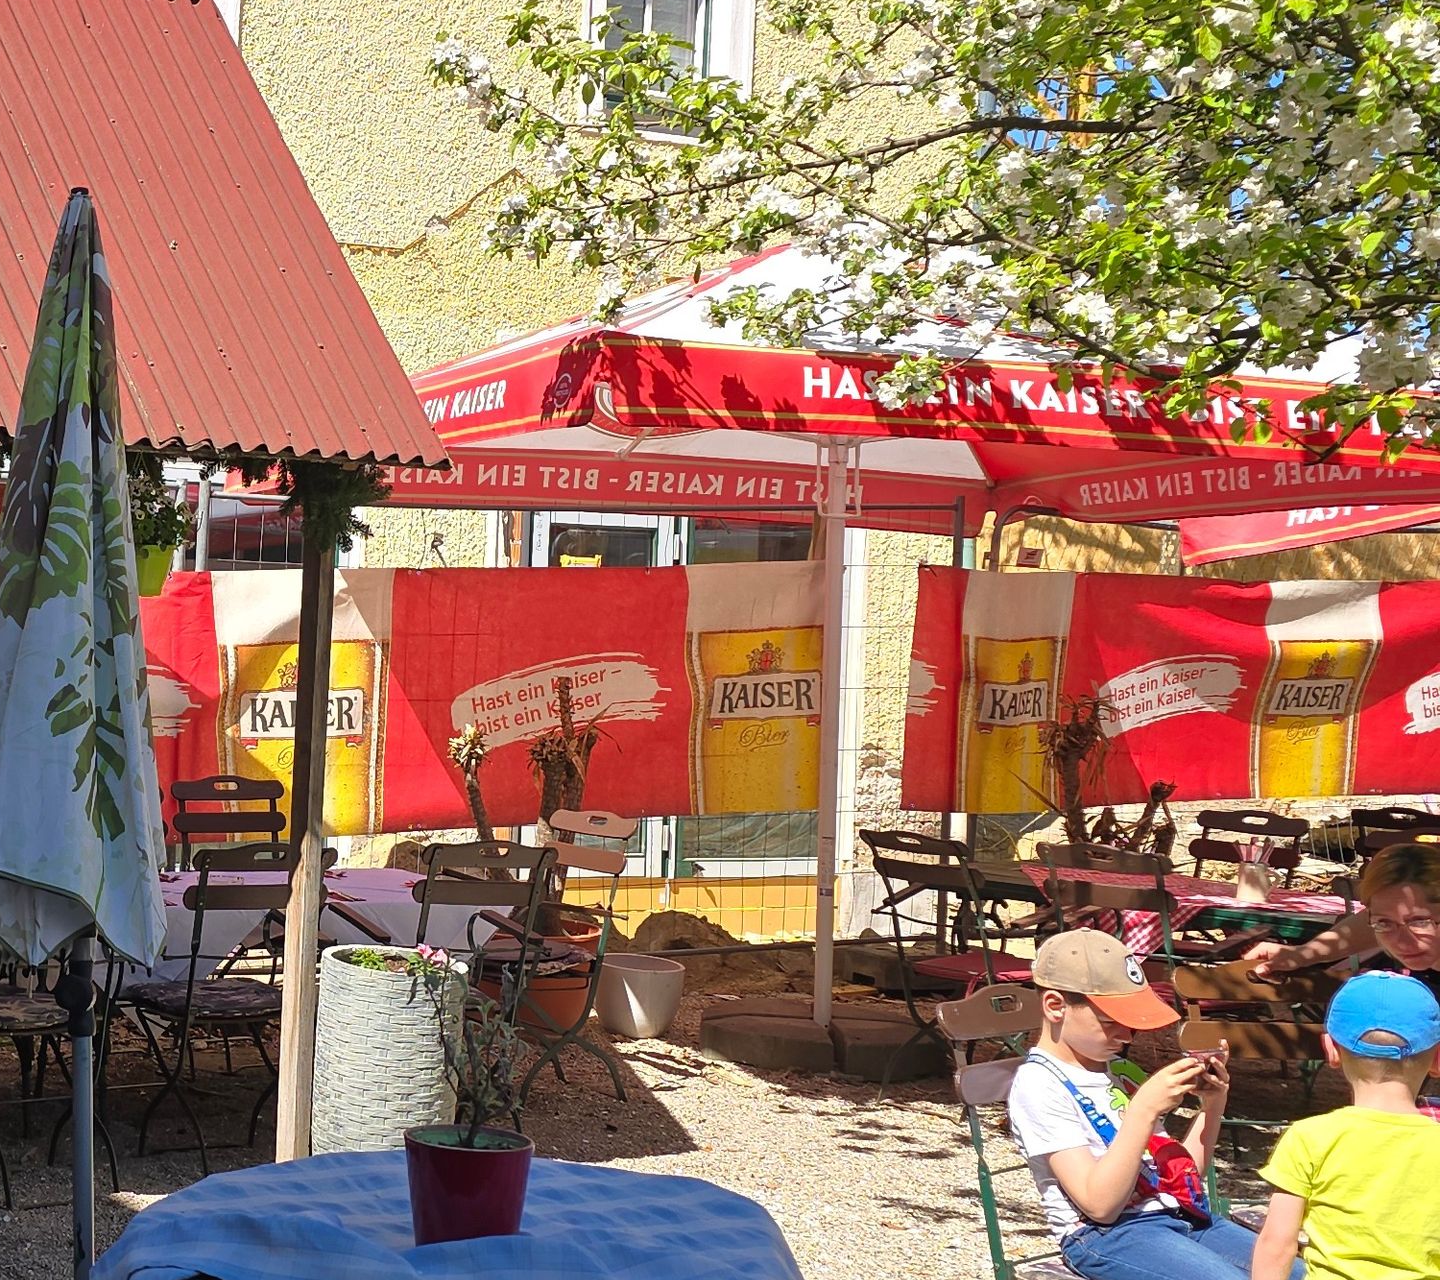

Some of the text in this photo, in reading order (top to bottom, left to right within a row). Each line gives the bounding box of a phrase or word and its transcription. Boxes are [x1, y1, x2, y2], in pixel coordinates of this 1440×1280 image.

[450, 380, 507, 419] KAISER
[803, 366, 880, 401] HAS
[925, 374, 993, 407] IN
[1009, 379, 1151, 419] KAISER
[471, 691, 513, 714] Hast
[517, 683, 545, 702] ein
[718, 679, 814, 713] KAISER
[1109, 684, 1136, 702] Hast
[1139, 677, 1158, 693] ein
[1162, 668, 1207, 686] Kaiser
[1134, 697, 1153, 715] ein
[1157, 687, 1198, 708] Kaiser
[1275, 684, 1345, 710] KAISER
[250, 695, 356, 733] KAIER
[475, 691, 602, 736] bist ein Kiser
[739, 722, 790, 753] Bier
